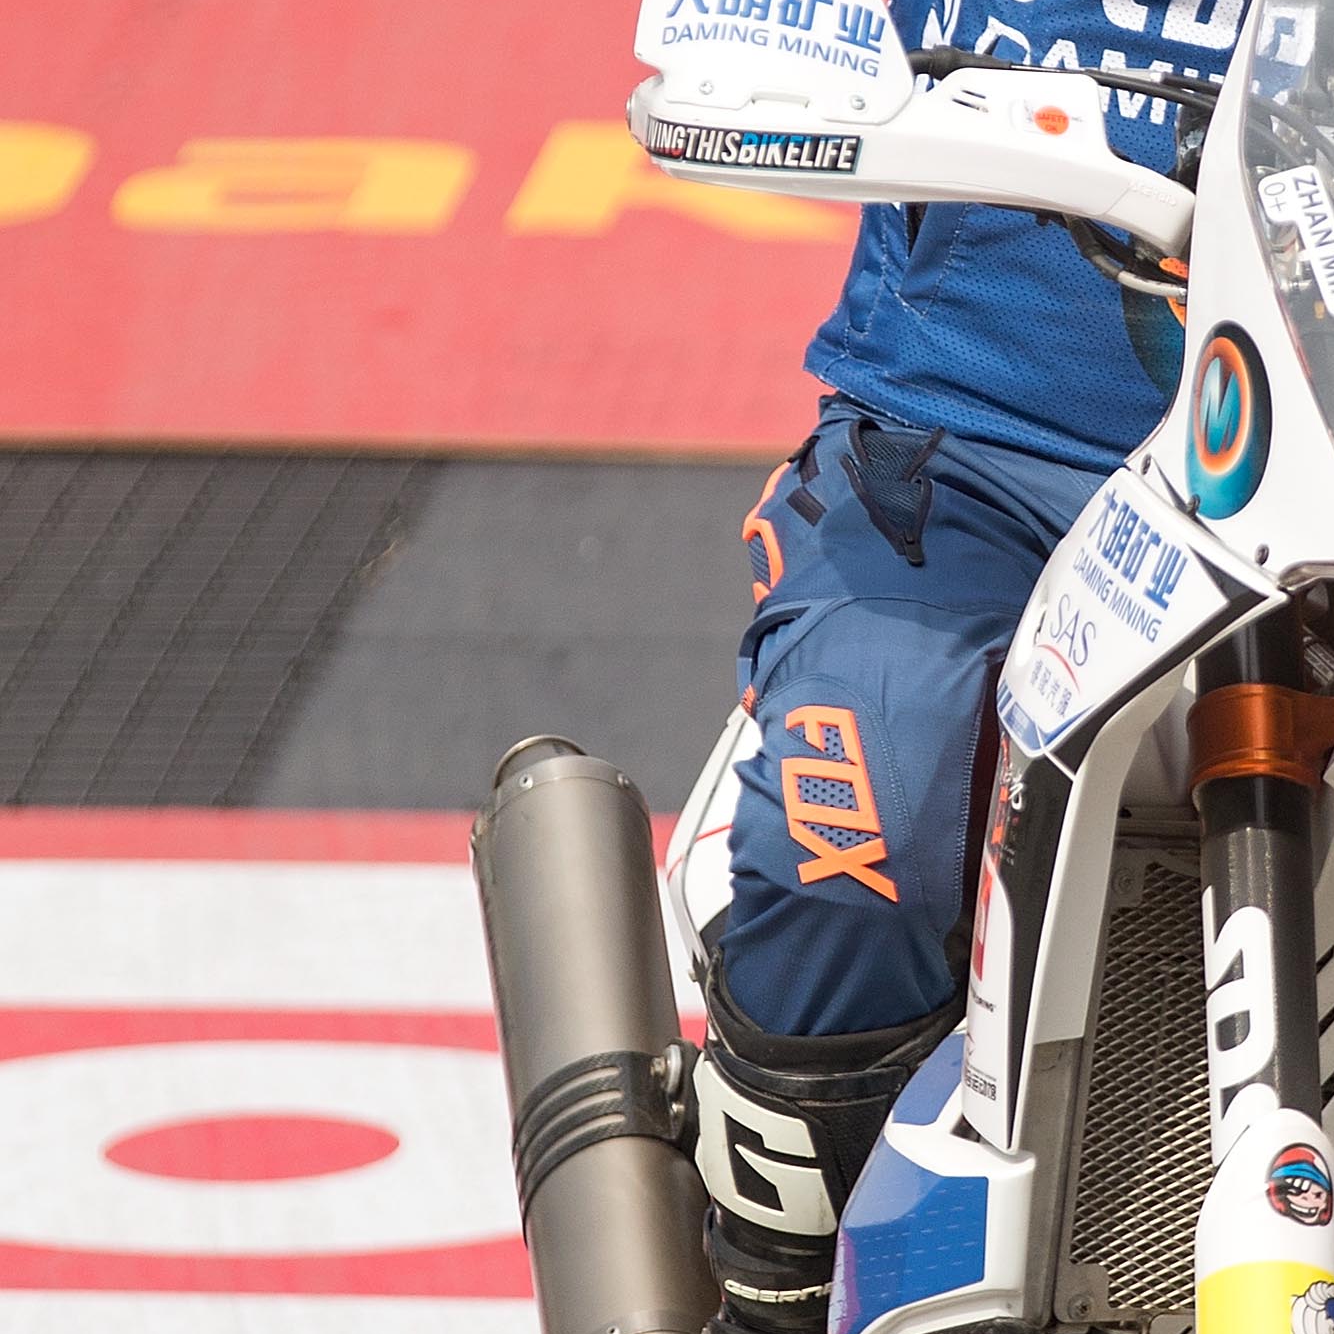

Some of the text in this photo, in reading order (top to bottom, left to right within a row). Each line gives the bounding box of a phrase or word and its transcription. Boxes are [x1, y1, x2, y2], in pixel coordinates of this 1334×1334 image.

[662, 22, 881, 79] DAMING MINING
[1072, 547, 1164, 644] DAMING MINING
[1087, 487, 1189, 612] 大明矿业
[1050, 593, 1097, 668] SAS
[781, 705, 899, 903] FOX
